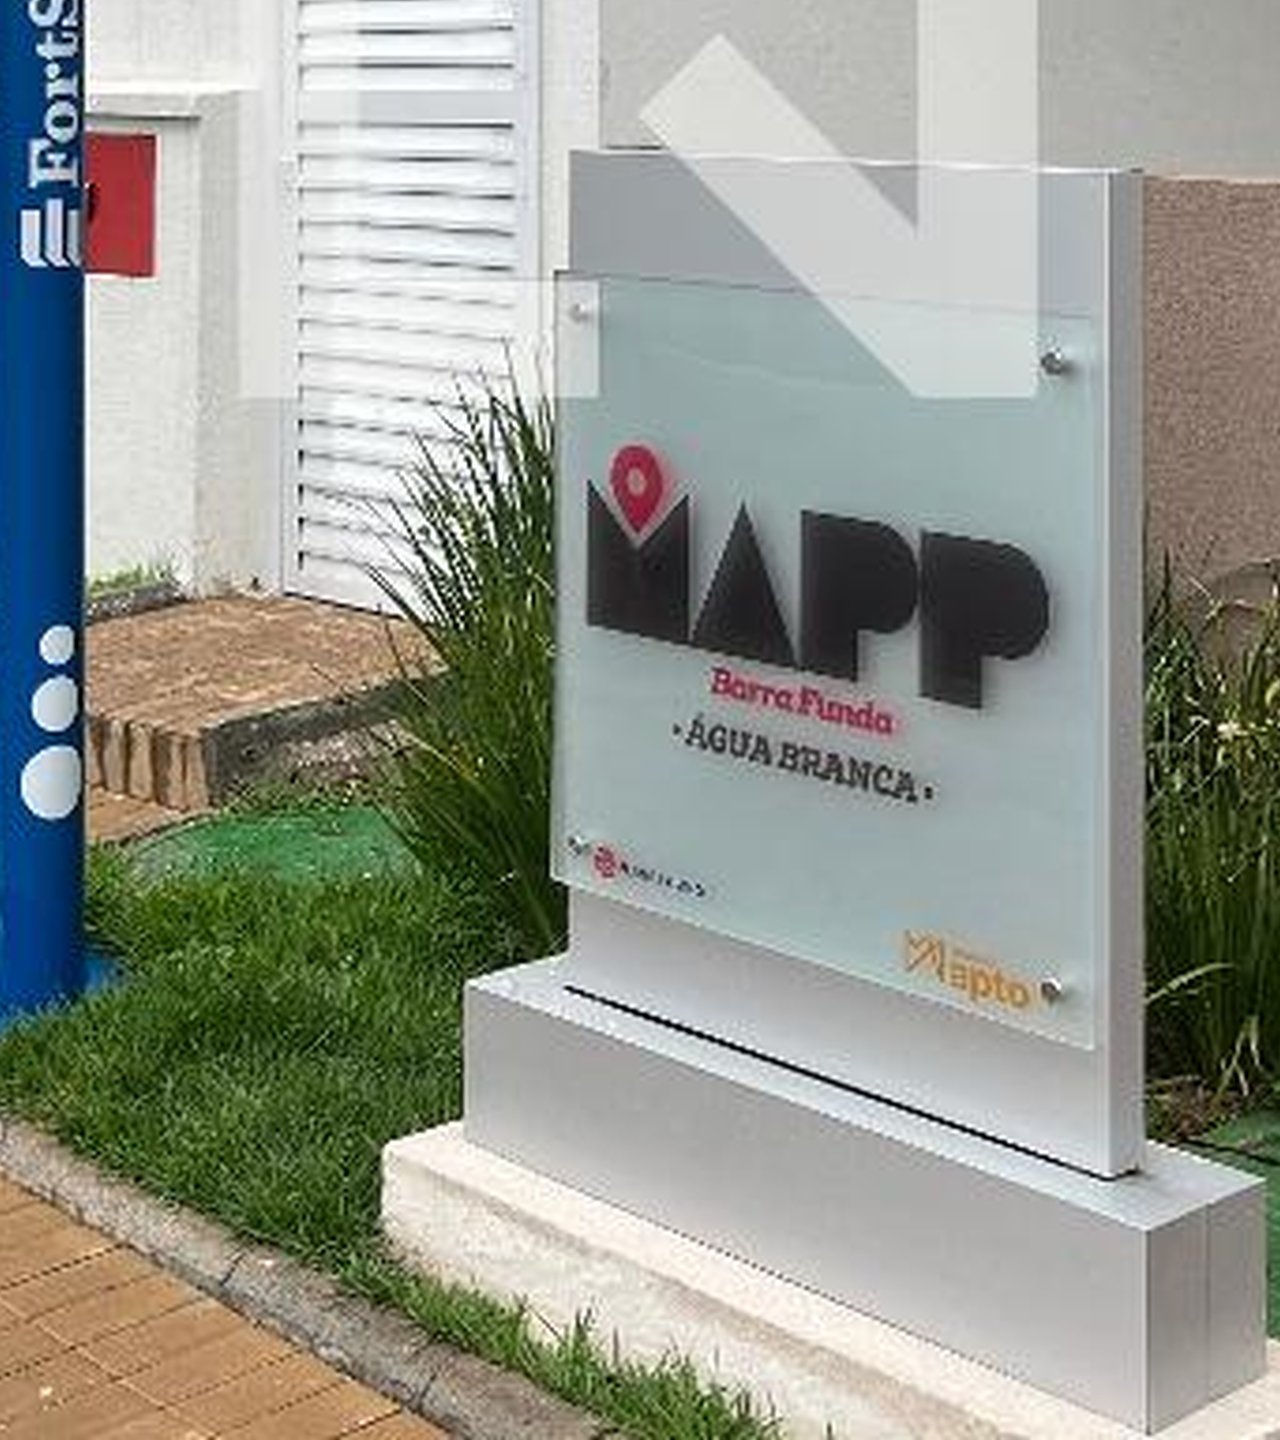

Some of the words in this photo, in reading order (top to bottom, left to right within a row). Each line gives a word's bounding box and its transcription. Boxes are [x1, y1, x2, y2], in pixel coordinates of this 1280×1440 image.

[586, 477, 1050, 709] MAPP
[710, 667, 793, 711] Barra
[797, 686, 894, 734] Funda
[684, 713, 772, 765] ÁGUA
[776, 742, 919, 802] BRANCA
